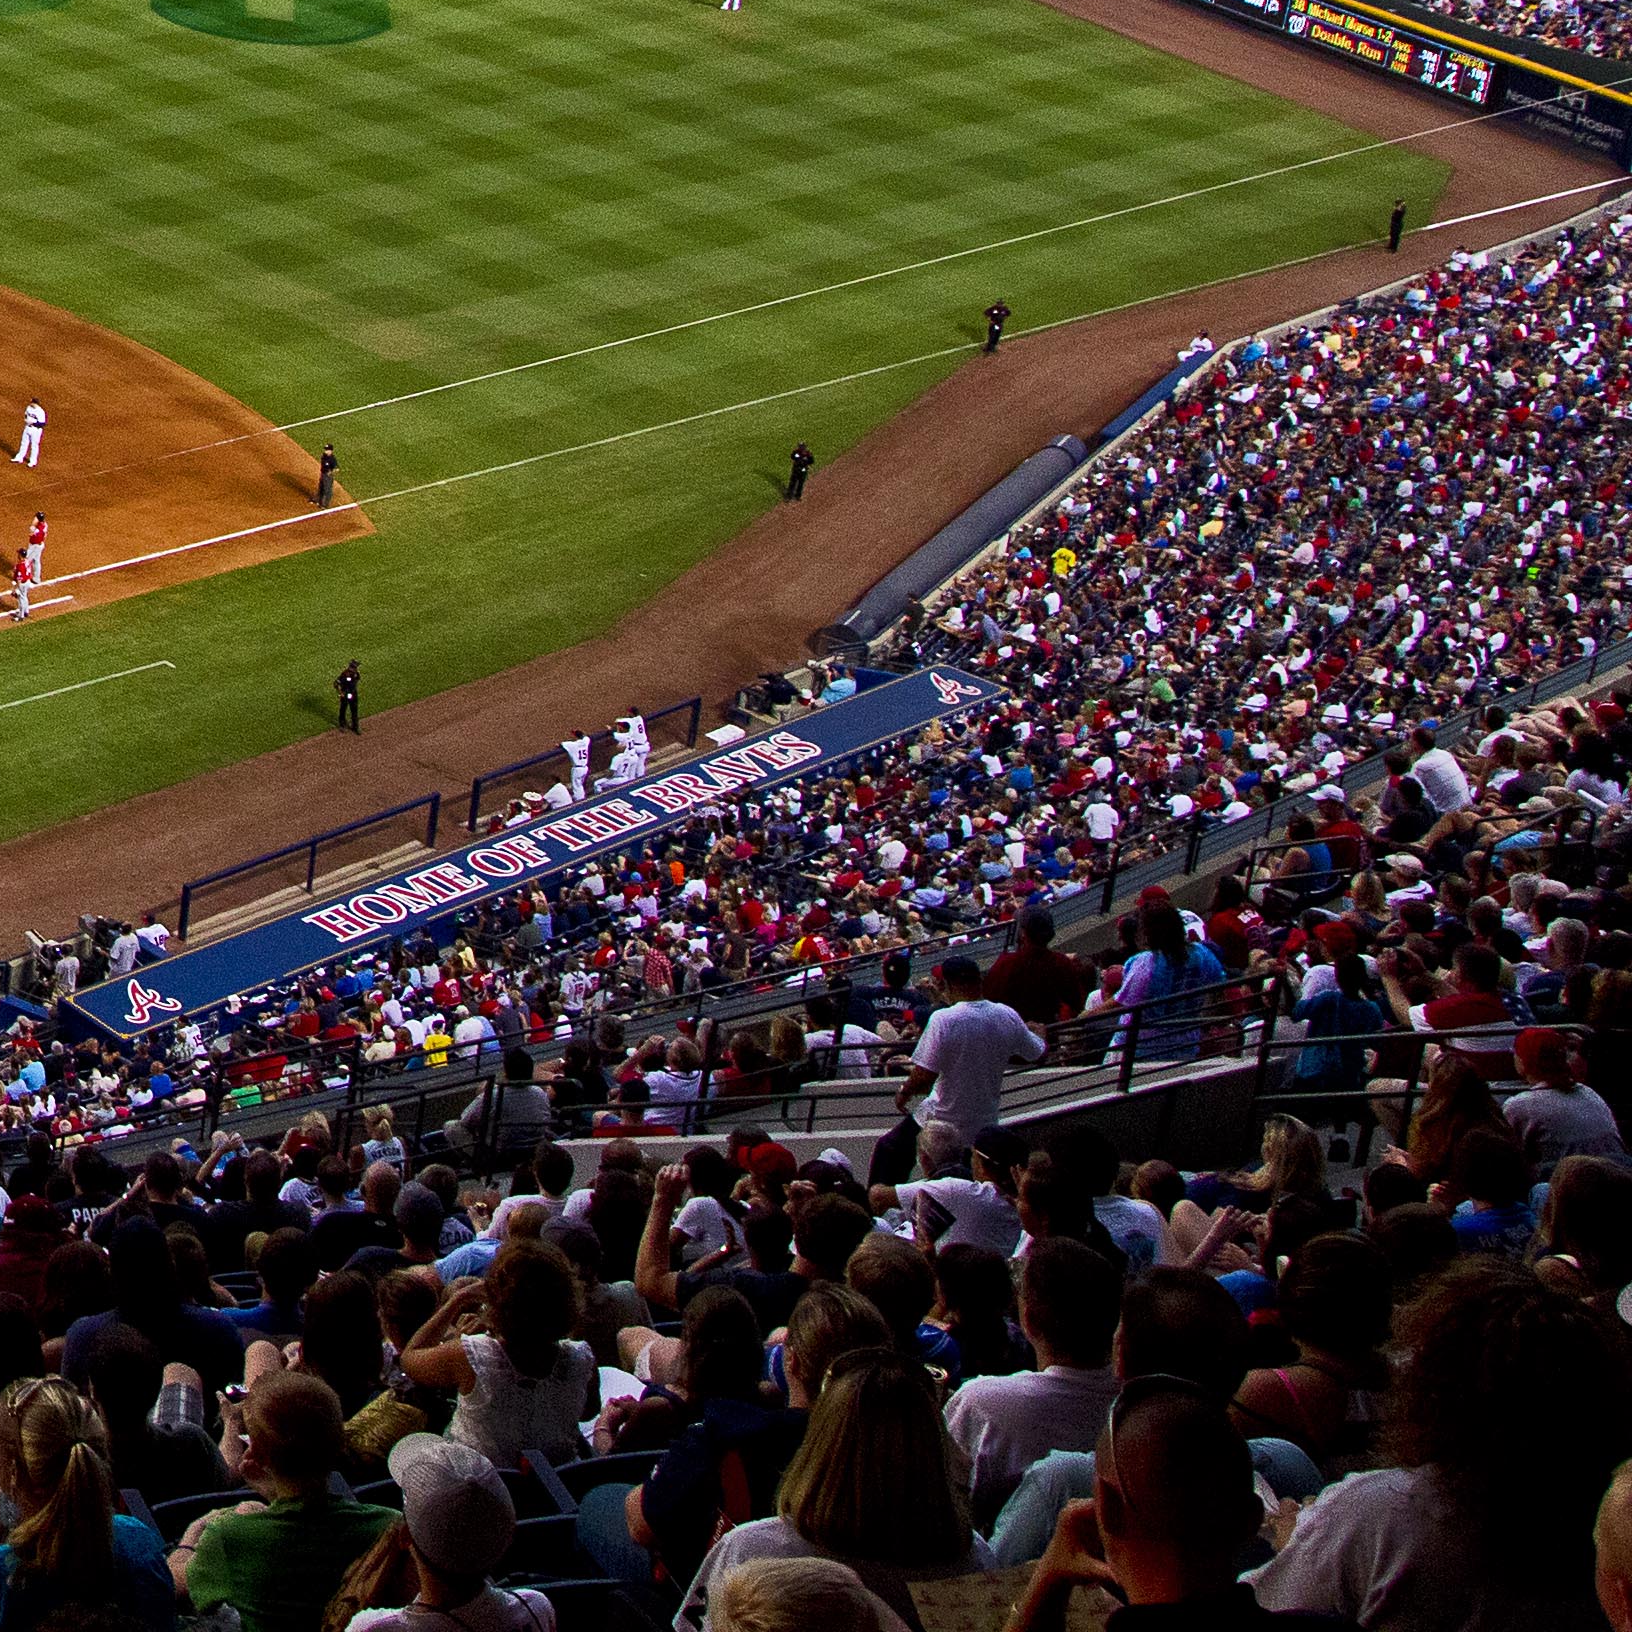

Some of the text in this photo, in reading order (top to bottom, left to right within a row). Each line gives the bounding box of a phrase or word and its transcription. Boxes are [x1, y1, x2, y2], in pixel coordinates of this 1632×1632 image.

[1308, 2, 1377, 39] Michael Morse
[1311, 24, 1383, 62] Double, Run
[302, 731, 824, 944] HOME OF THE BRAVES
